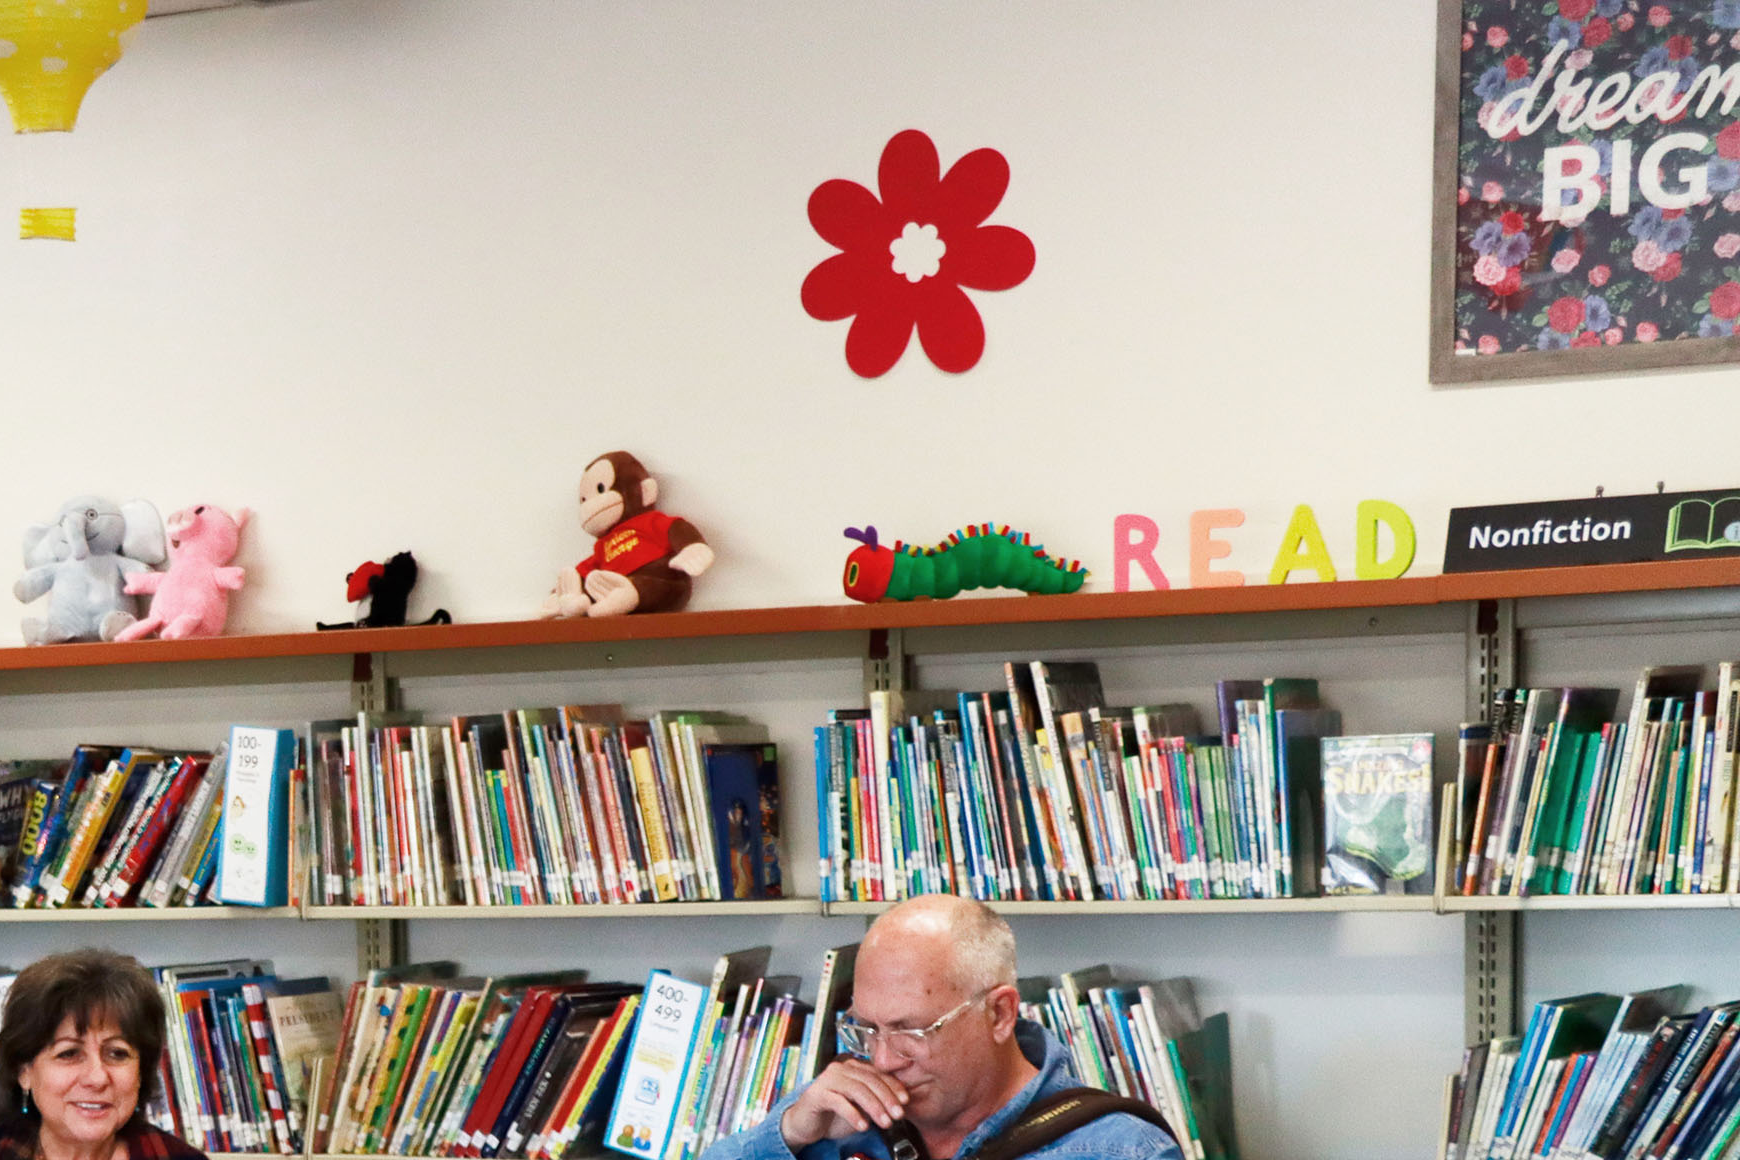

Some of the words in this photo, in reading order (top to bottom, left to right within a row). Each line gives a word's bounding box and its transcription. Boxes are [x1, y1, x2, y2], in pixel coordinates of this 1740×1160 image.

[1542, 131, 1709, 222] BIG
[1468, 516, 1632, 550] Nonfiction
[1113, 498, 1417, 592] READ
[237, 735, 261, 750] 100-
[238, 755, 259, 769] 199
[656, 984, 689, 1004] 400-
[654, 1004, 682, 1023] 499
